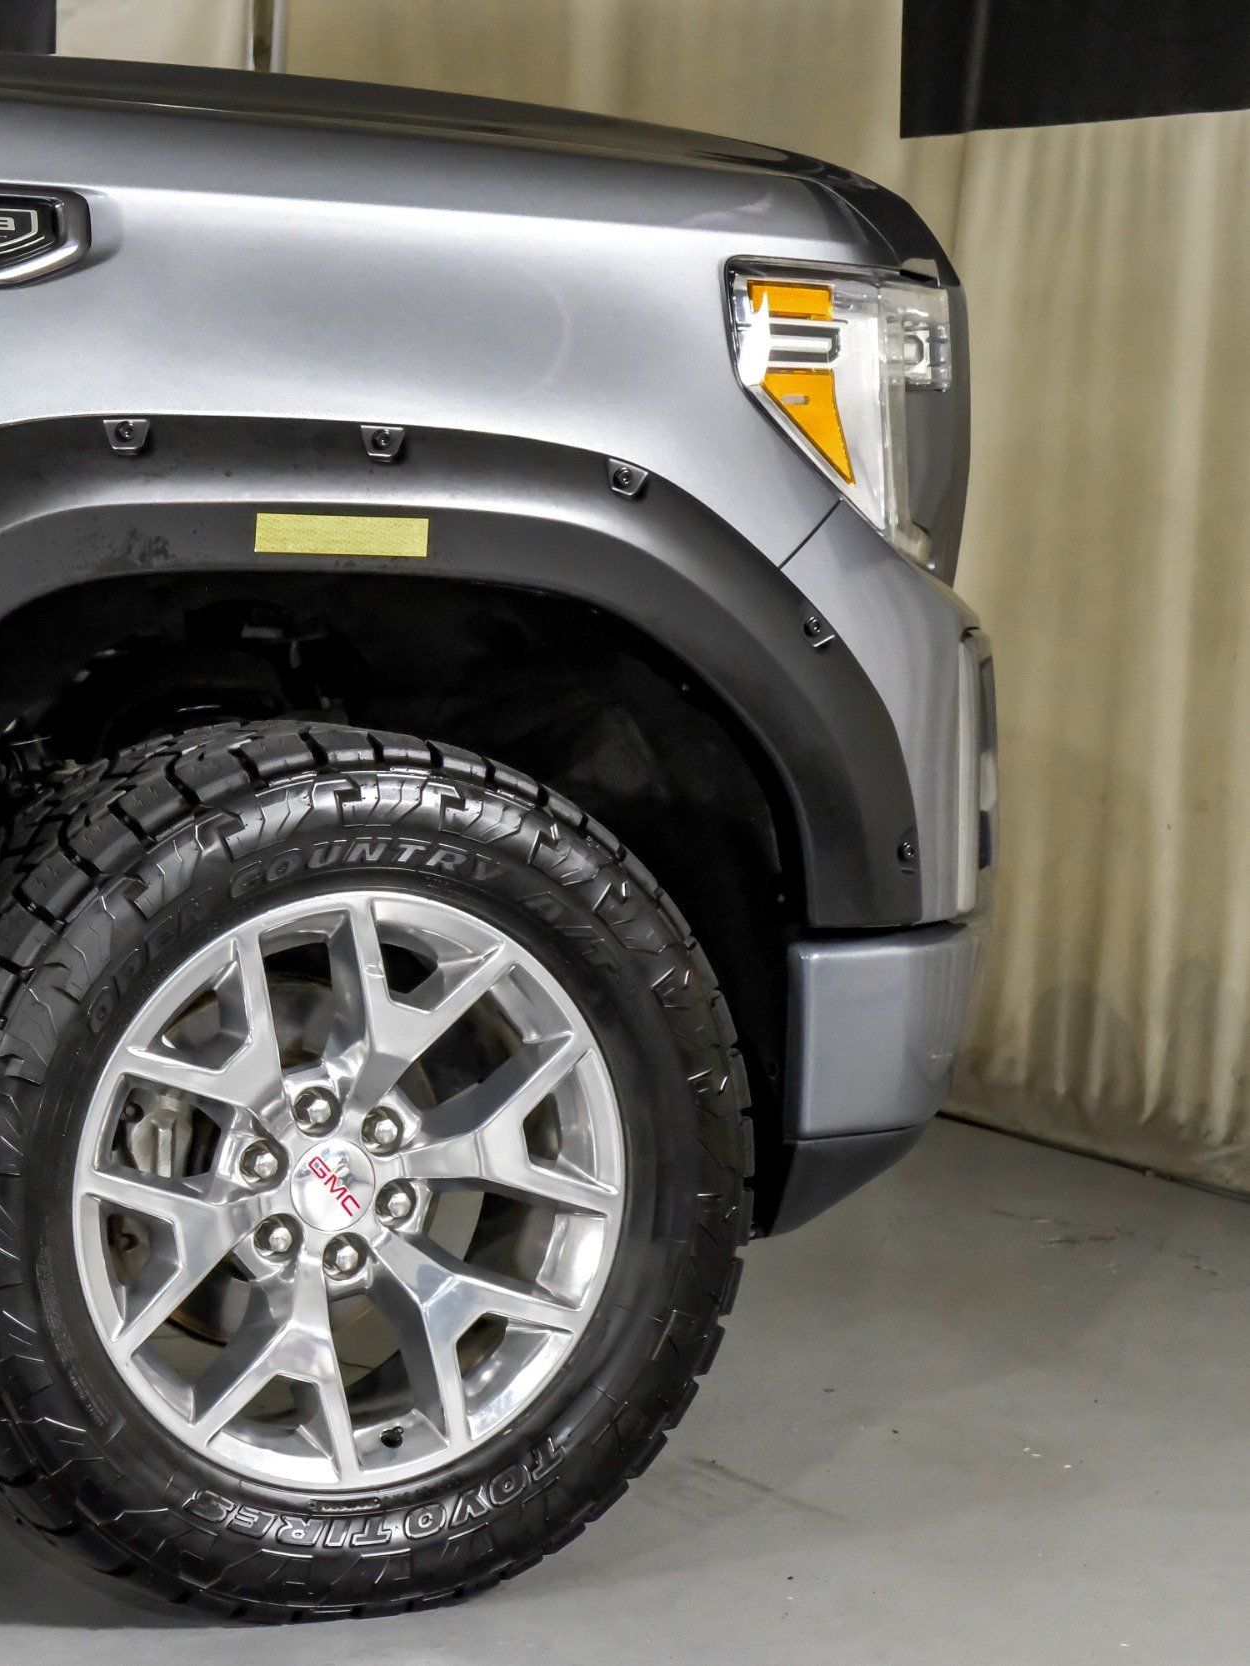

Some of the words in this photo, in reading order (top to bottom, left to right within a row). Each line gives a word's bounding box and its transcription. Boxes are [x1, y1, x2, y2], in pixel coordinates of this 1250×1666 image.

[227, 837, 505, 899] COUNTRY
[308, 1156, 361, 1217] GMC
[182, 1489, 395, 1548] TIRES
[402, 1438, 567, 1540] TOYO
